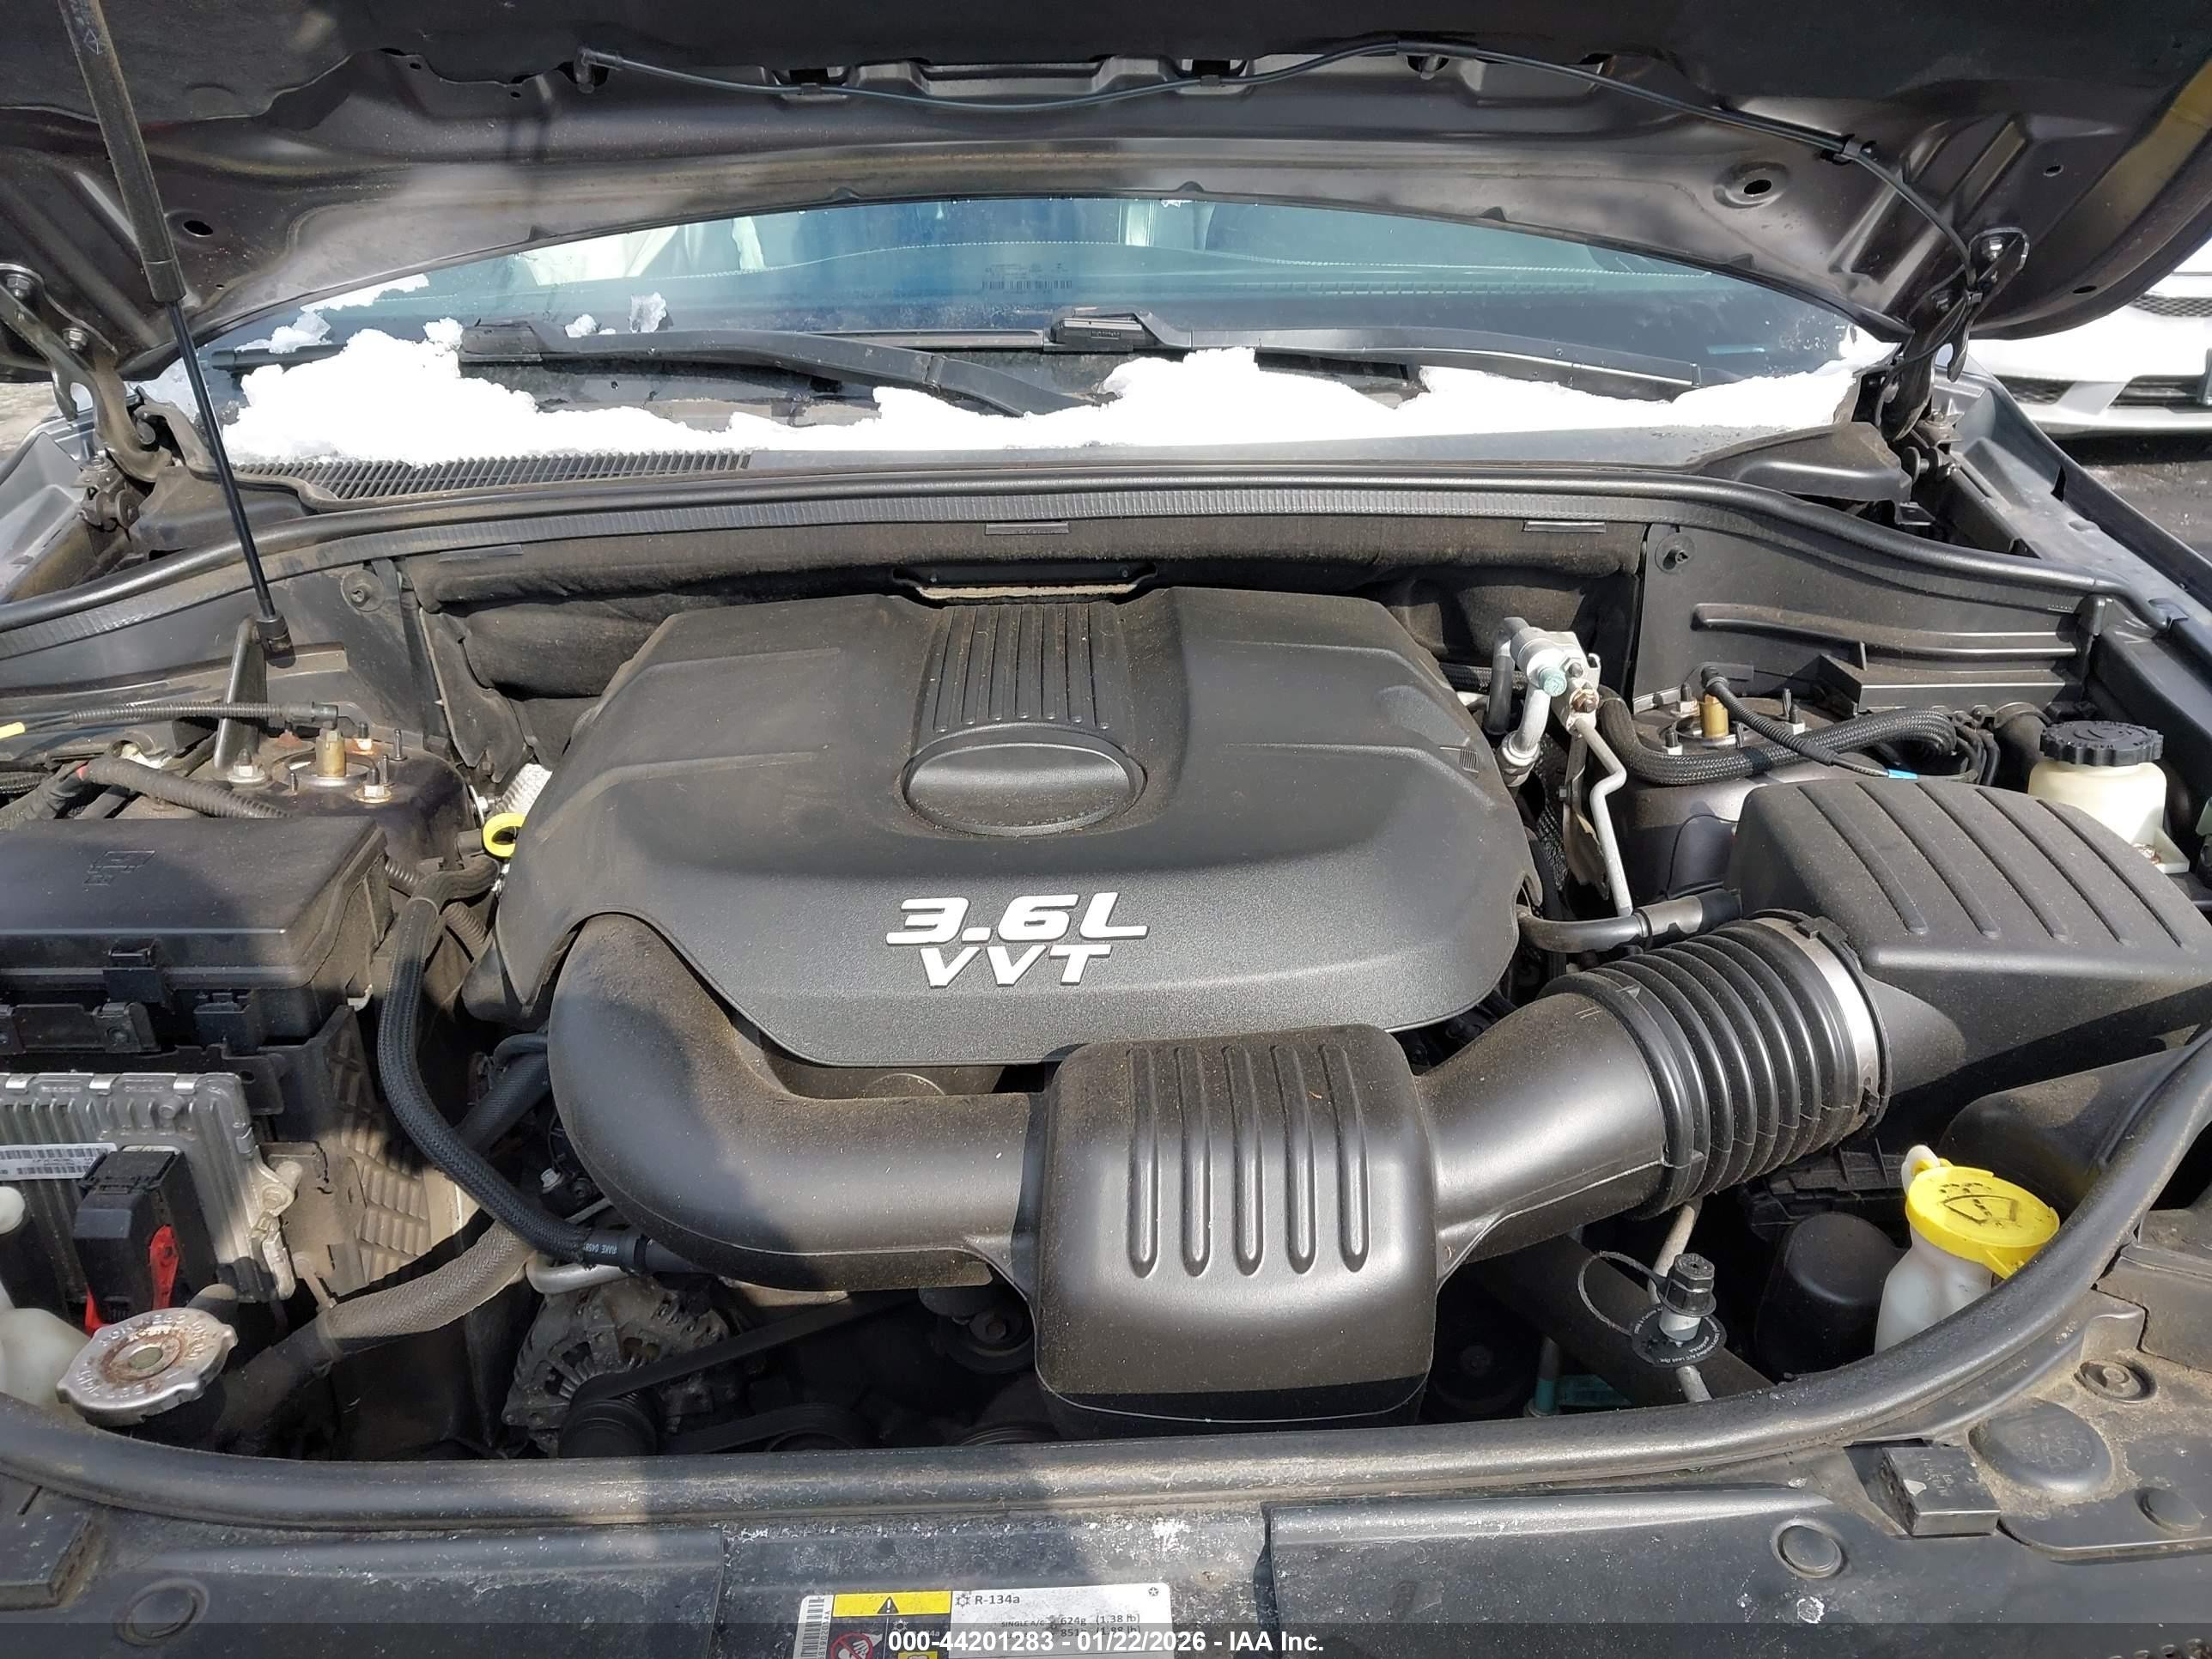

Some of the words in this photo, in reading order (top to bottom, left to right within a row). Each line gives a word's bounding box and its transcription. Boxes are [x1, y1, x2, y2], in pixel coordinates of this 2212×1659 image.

[886, 892, 1150, 945] 3.6L
[920, 945, 1113, 988] VVT
[975, 1595, 1020, 1605] R-134a
[1060, 1616, 1087, 1626] 624g
[1096, 1614, 1123, 1625] (1.38
